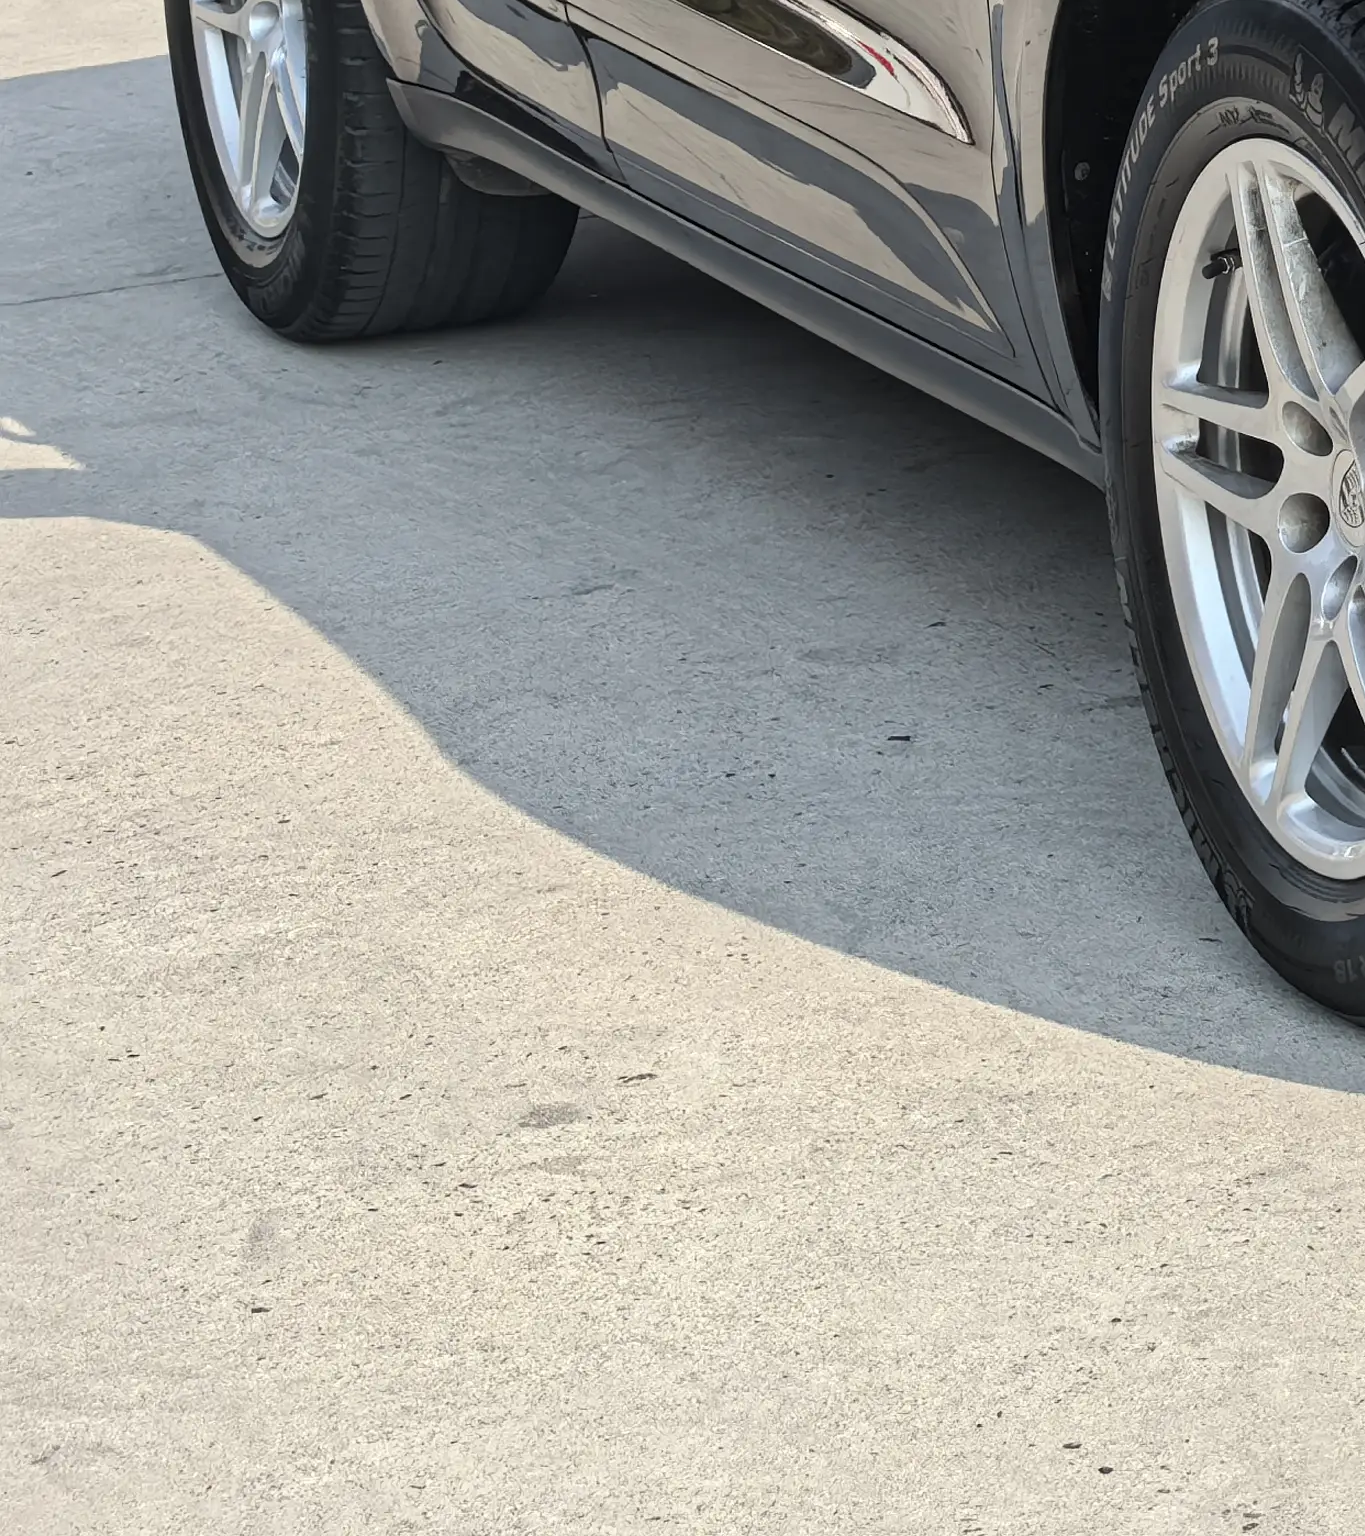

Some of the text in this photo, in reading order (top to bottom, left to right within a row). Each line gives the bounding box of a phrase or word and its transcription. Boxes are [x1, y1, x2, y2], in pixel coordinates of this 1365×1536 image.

[1107, 36, 1219, 260] LATITUDE Sport 3
